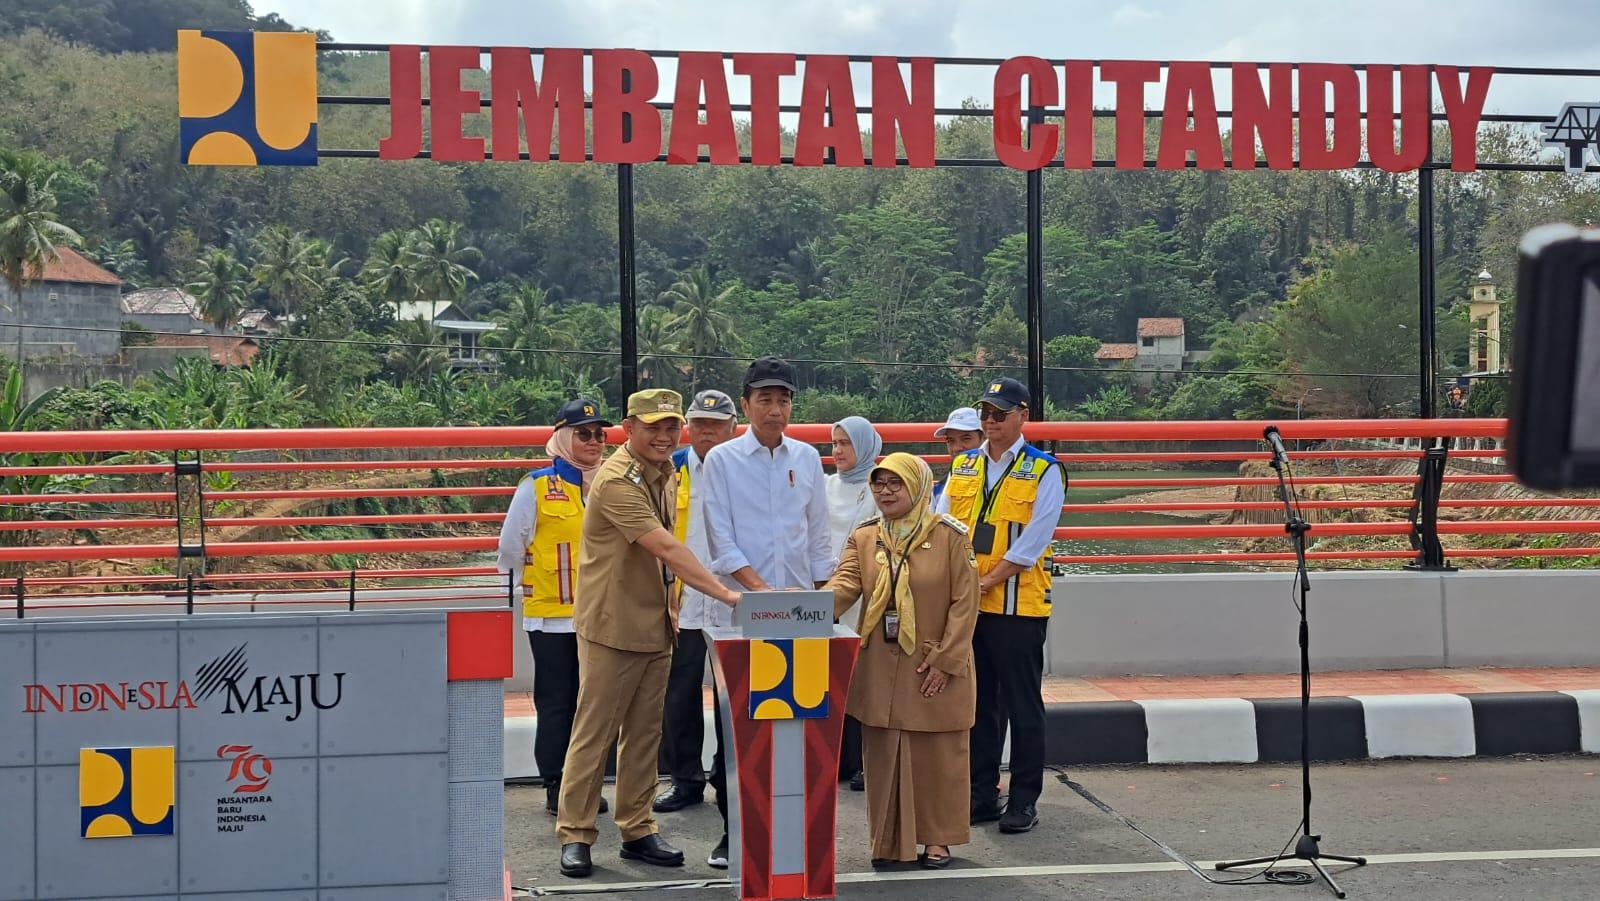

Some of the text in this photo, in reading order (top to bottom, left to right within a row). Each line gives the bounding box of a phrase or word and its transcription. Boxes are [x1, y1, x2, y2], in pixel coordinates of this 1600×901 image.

[379, 44, 935, 168] JEMBATAN
[993, 56, 1495, 173] CITANDUY
[22, 672, 346, 722] INDONESIA MAJU
[216, 744, 272, 794] 79
[217, 795, 272, 805] NUSANTARA
[217, 806, 242, 814] BARU
[217, 814, 267, 824] INDONESIA
[217, 824, 244, 833] MAJU
